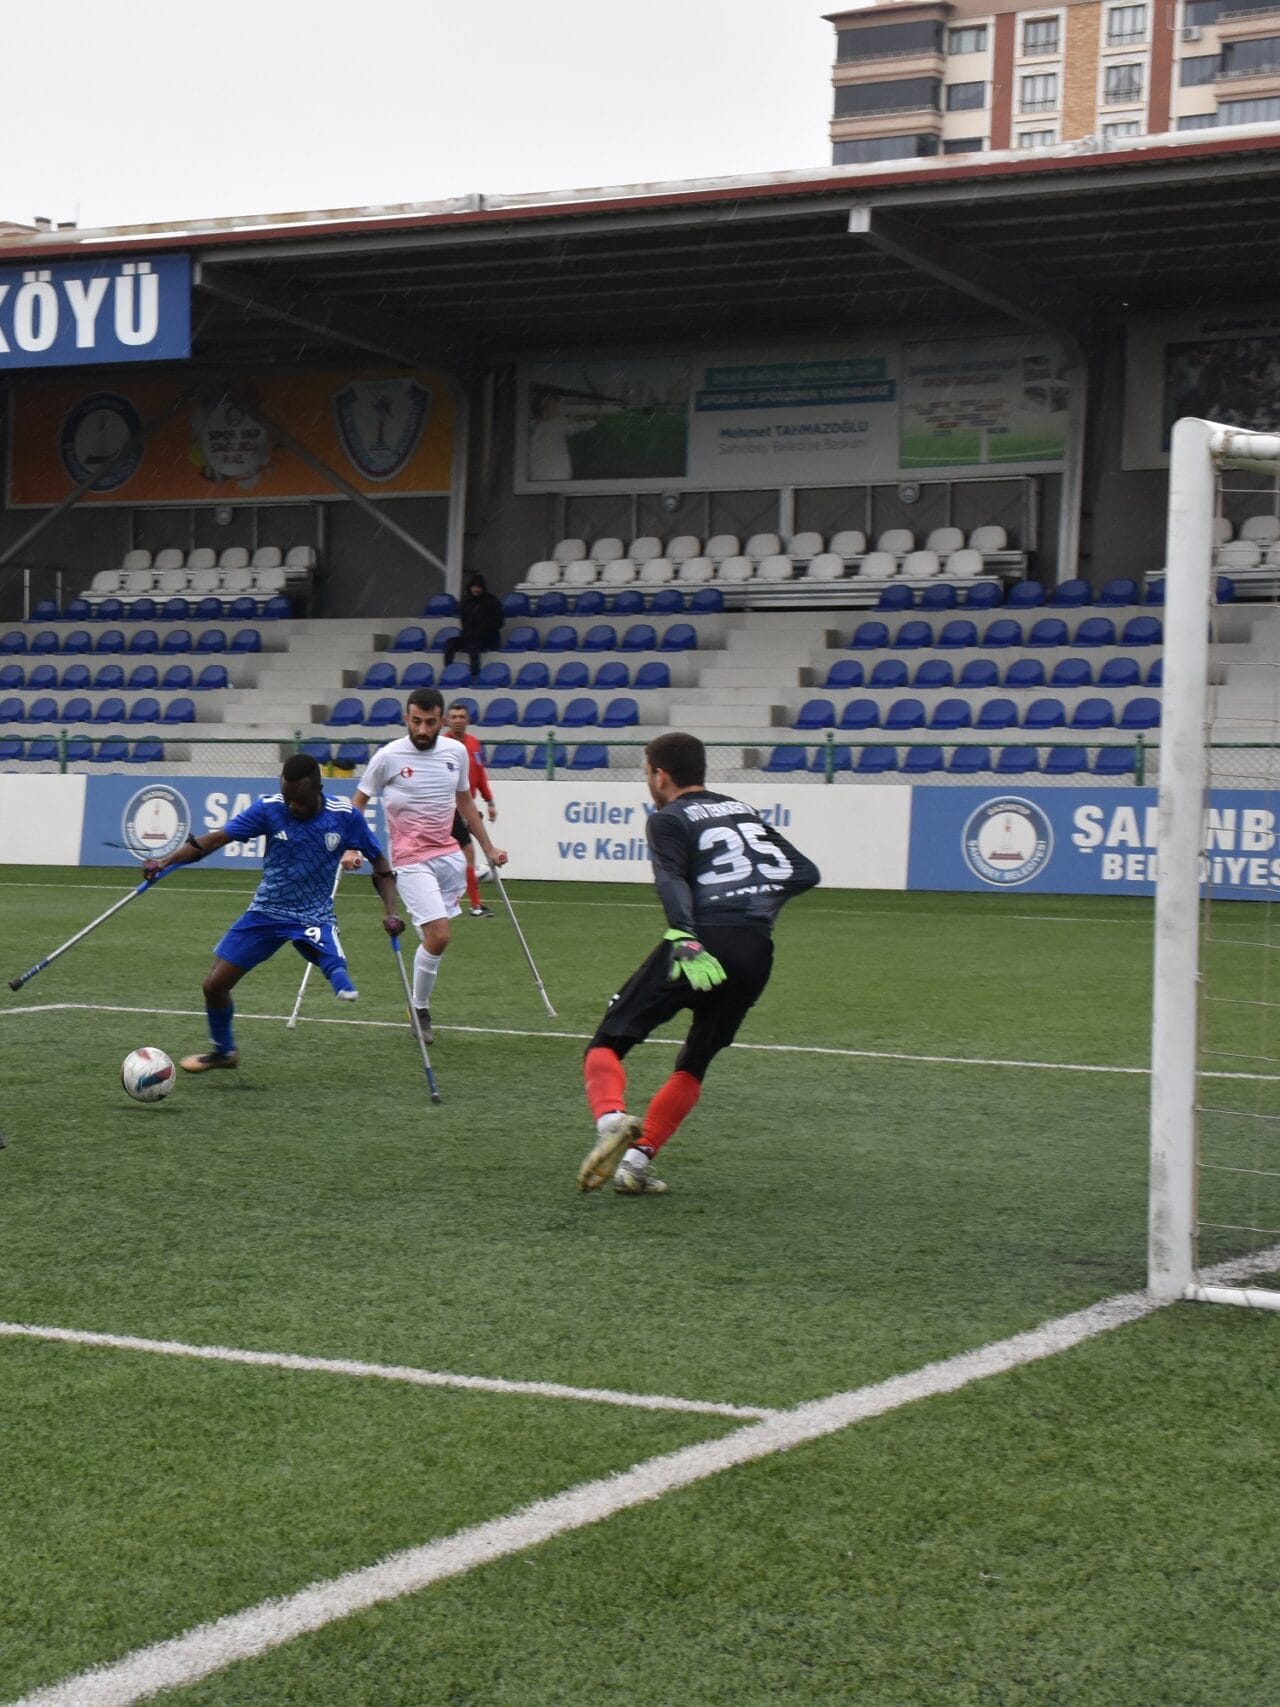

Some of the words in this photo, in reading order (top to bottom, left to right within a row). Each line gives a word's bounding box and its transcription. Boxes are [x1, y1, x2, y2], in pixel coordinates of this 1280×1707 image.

[564, 801, 635, 825] Güler
[557, 841, 587, 860] ve
[697, 822, 794, 885] 35
[304, 926, 322, 944] 9
